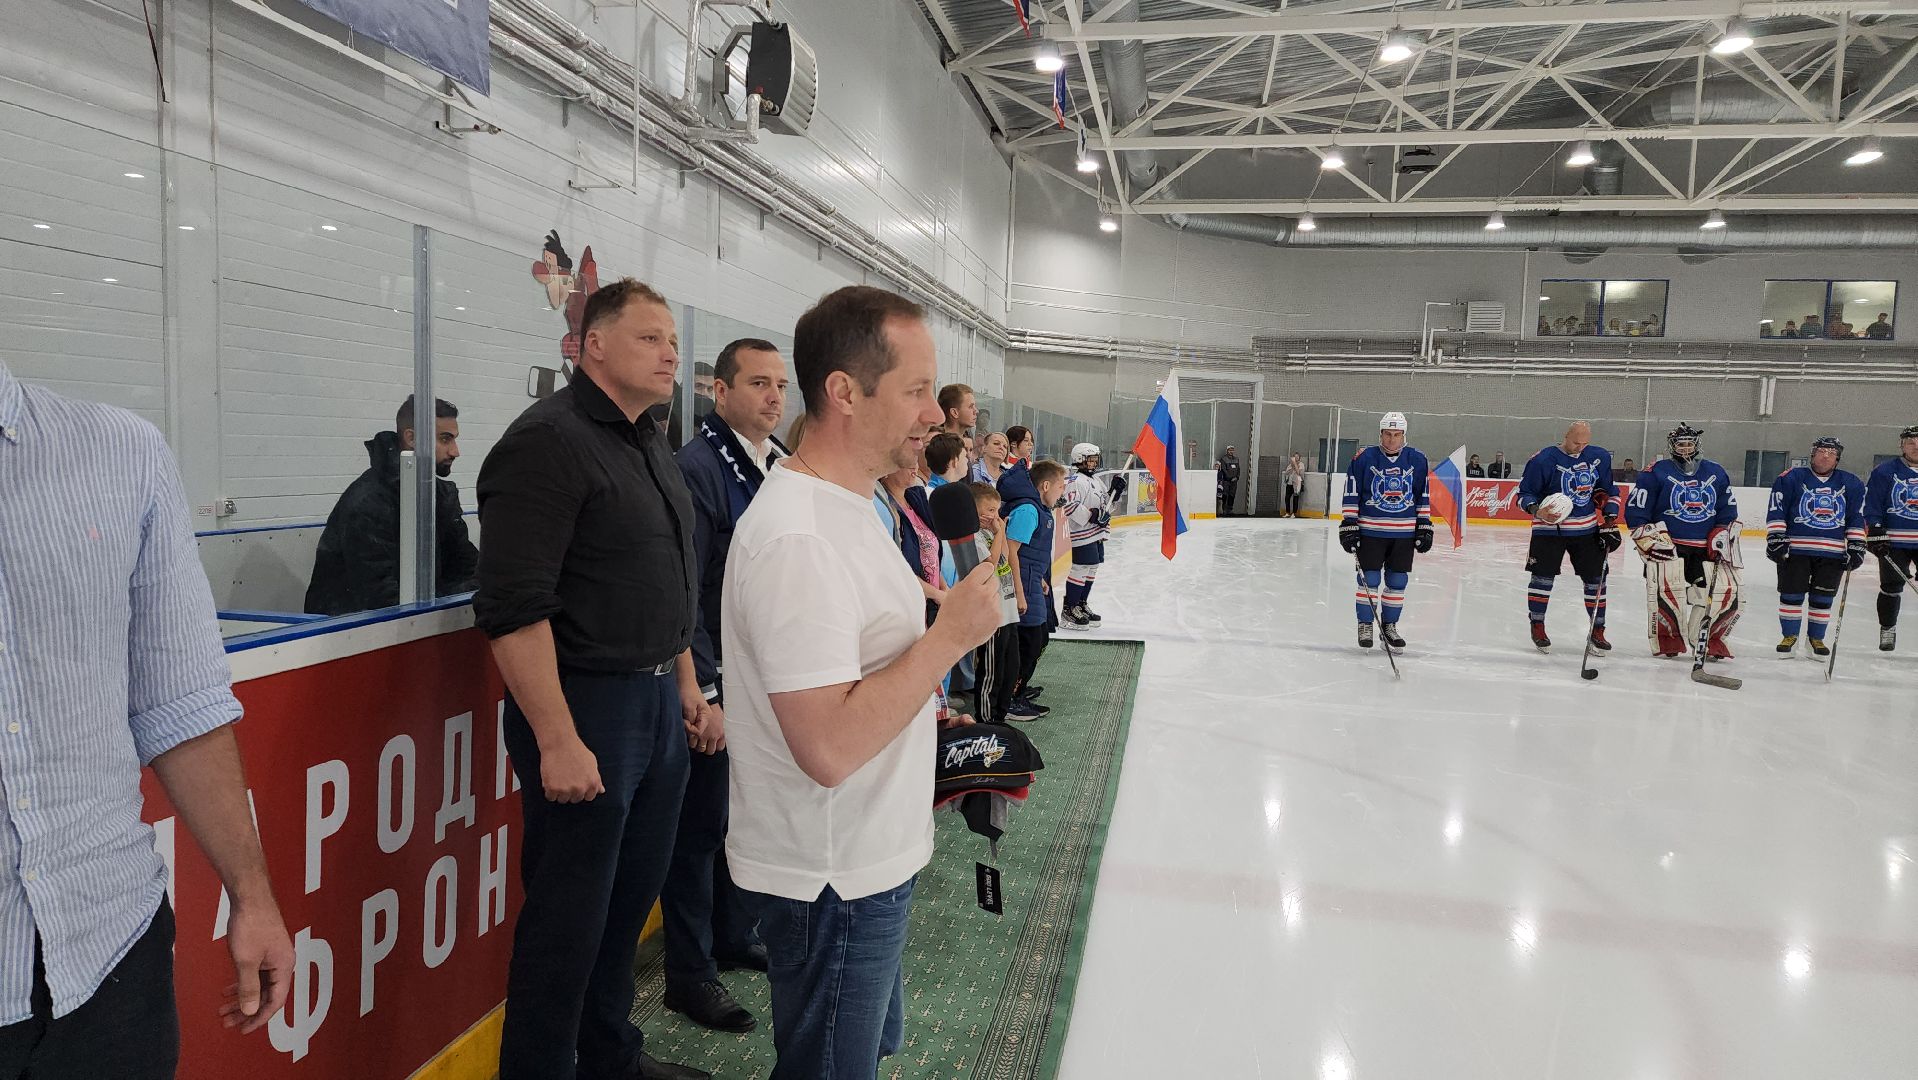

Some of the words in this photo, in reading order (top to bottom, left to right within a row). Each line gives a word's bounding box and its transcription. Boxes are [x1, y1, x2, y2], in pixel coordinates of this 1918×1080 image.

[1344, 475, 1359, 497] 11
[1628, 488, 1648, 508] 20
[1694, 629, 1708, 666] CCM
[945, 733, 999, 768] Capitals
